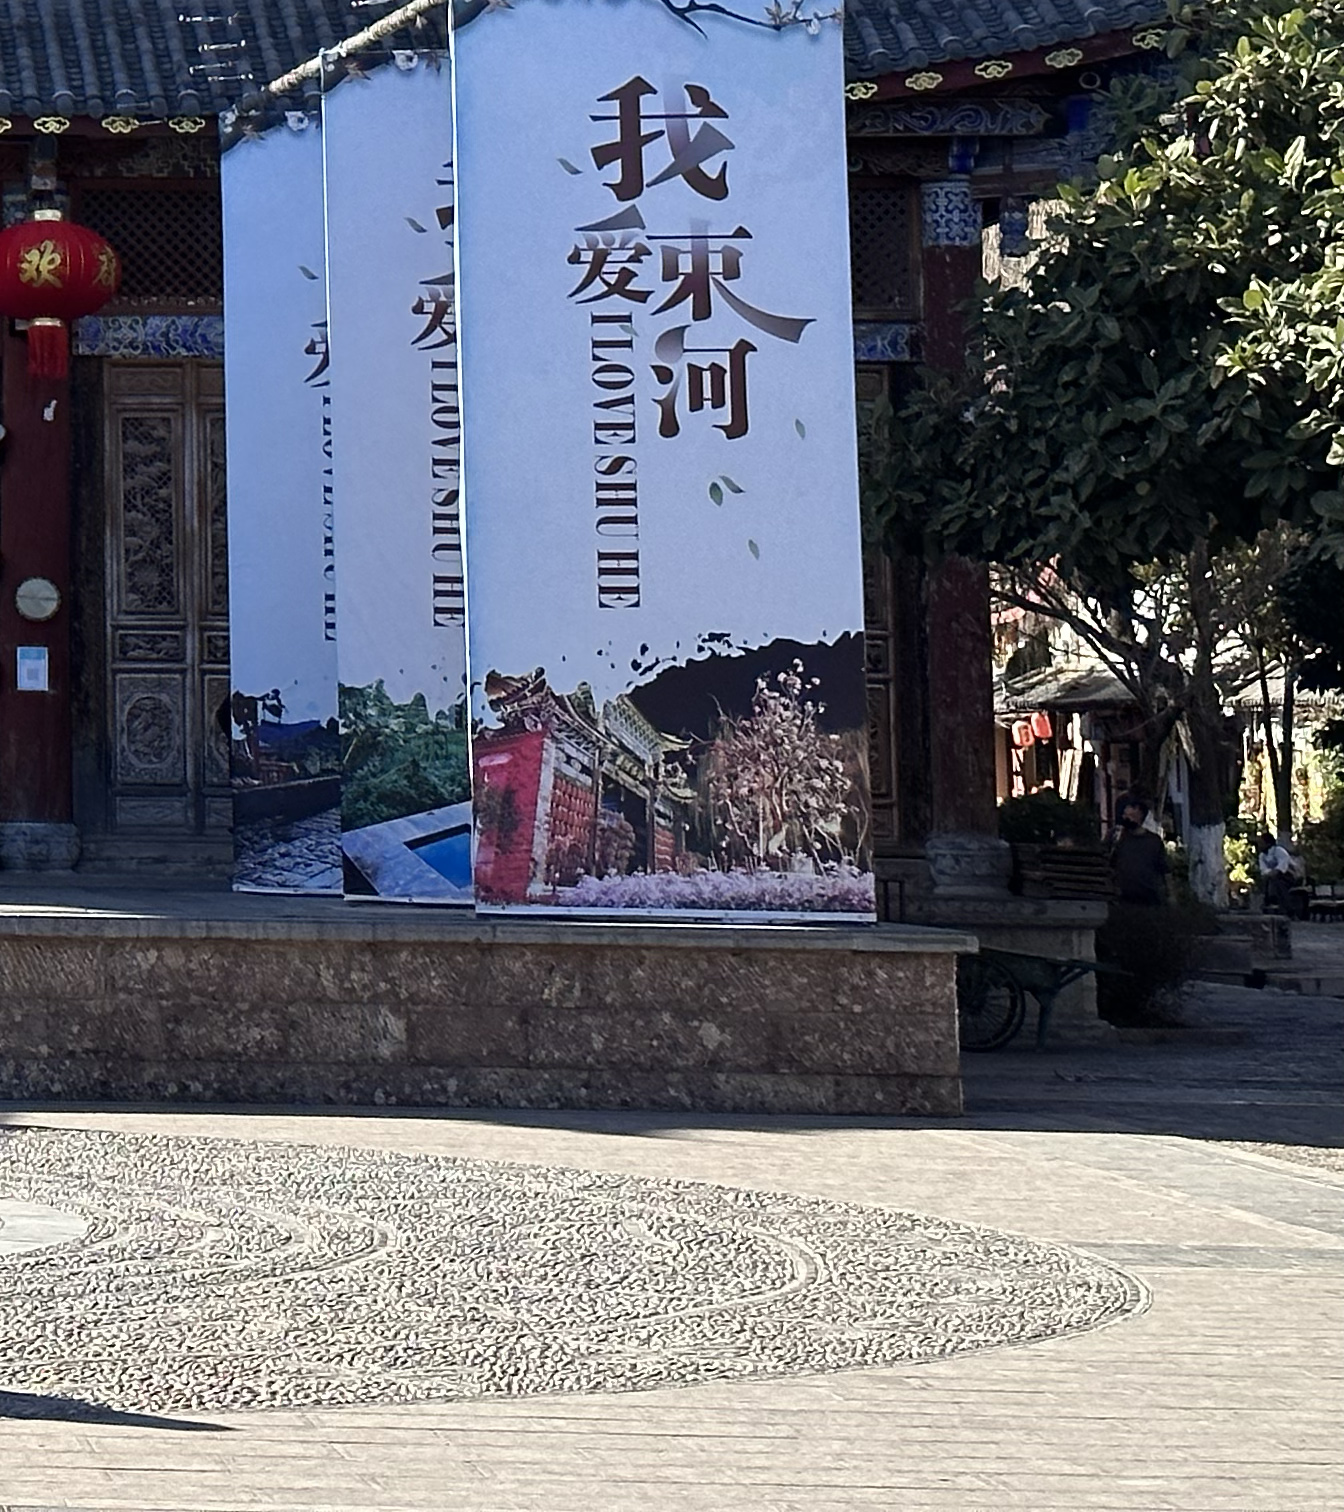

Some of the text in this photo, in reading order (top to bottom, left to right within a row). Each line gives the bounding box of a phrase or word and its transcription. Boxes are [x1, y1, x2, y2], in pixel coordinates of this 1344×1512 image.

[591, 335, 637, 445] LOVE
[594, 454, 640, 541] SHU
[596, 548, 641, 609] HE
